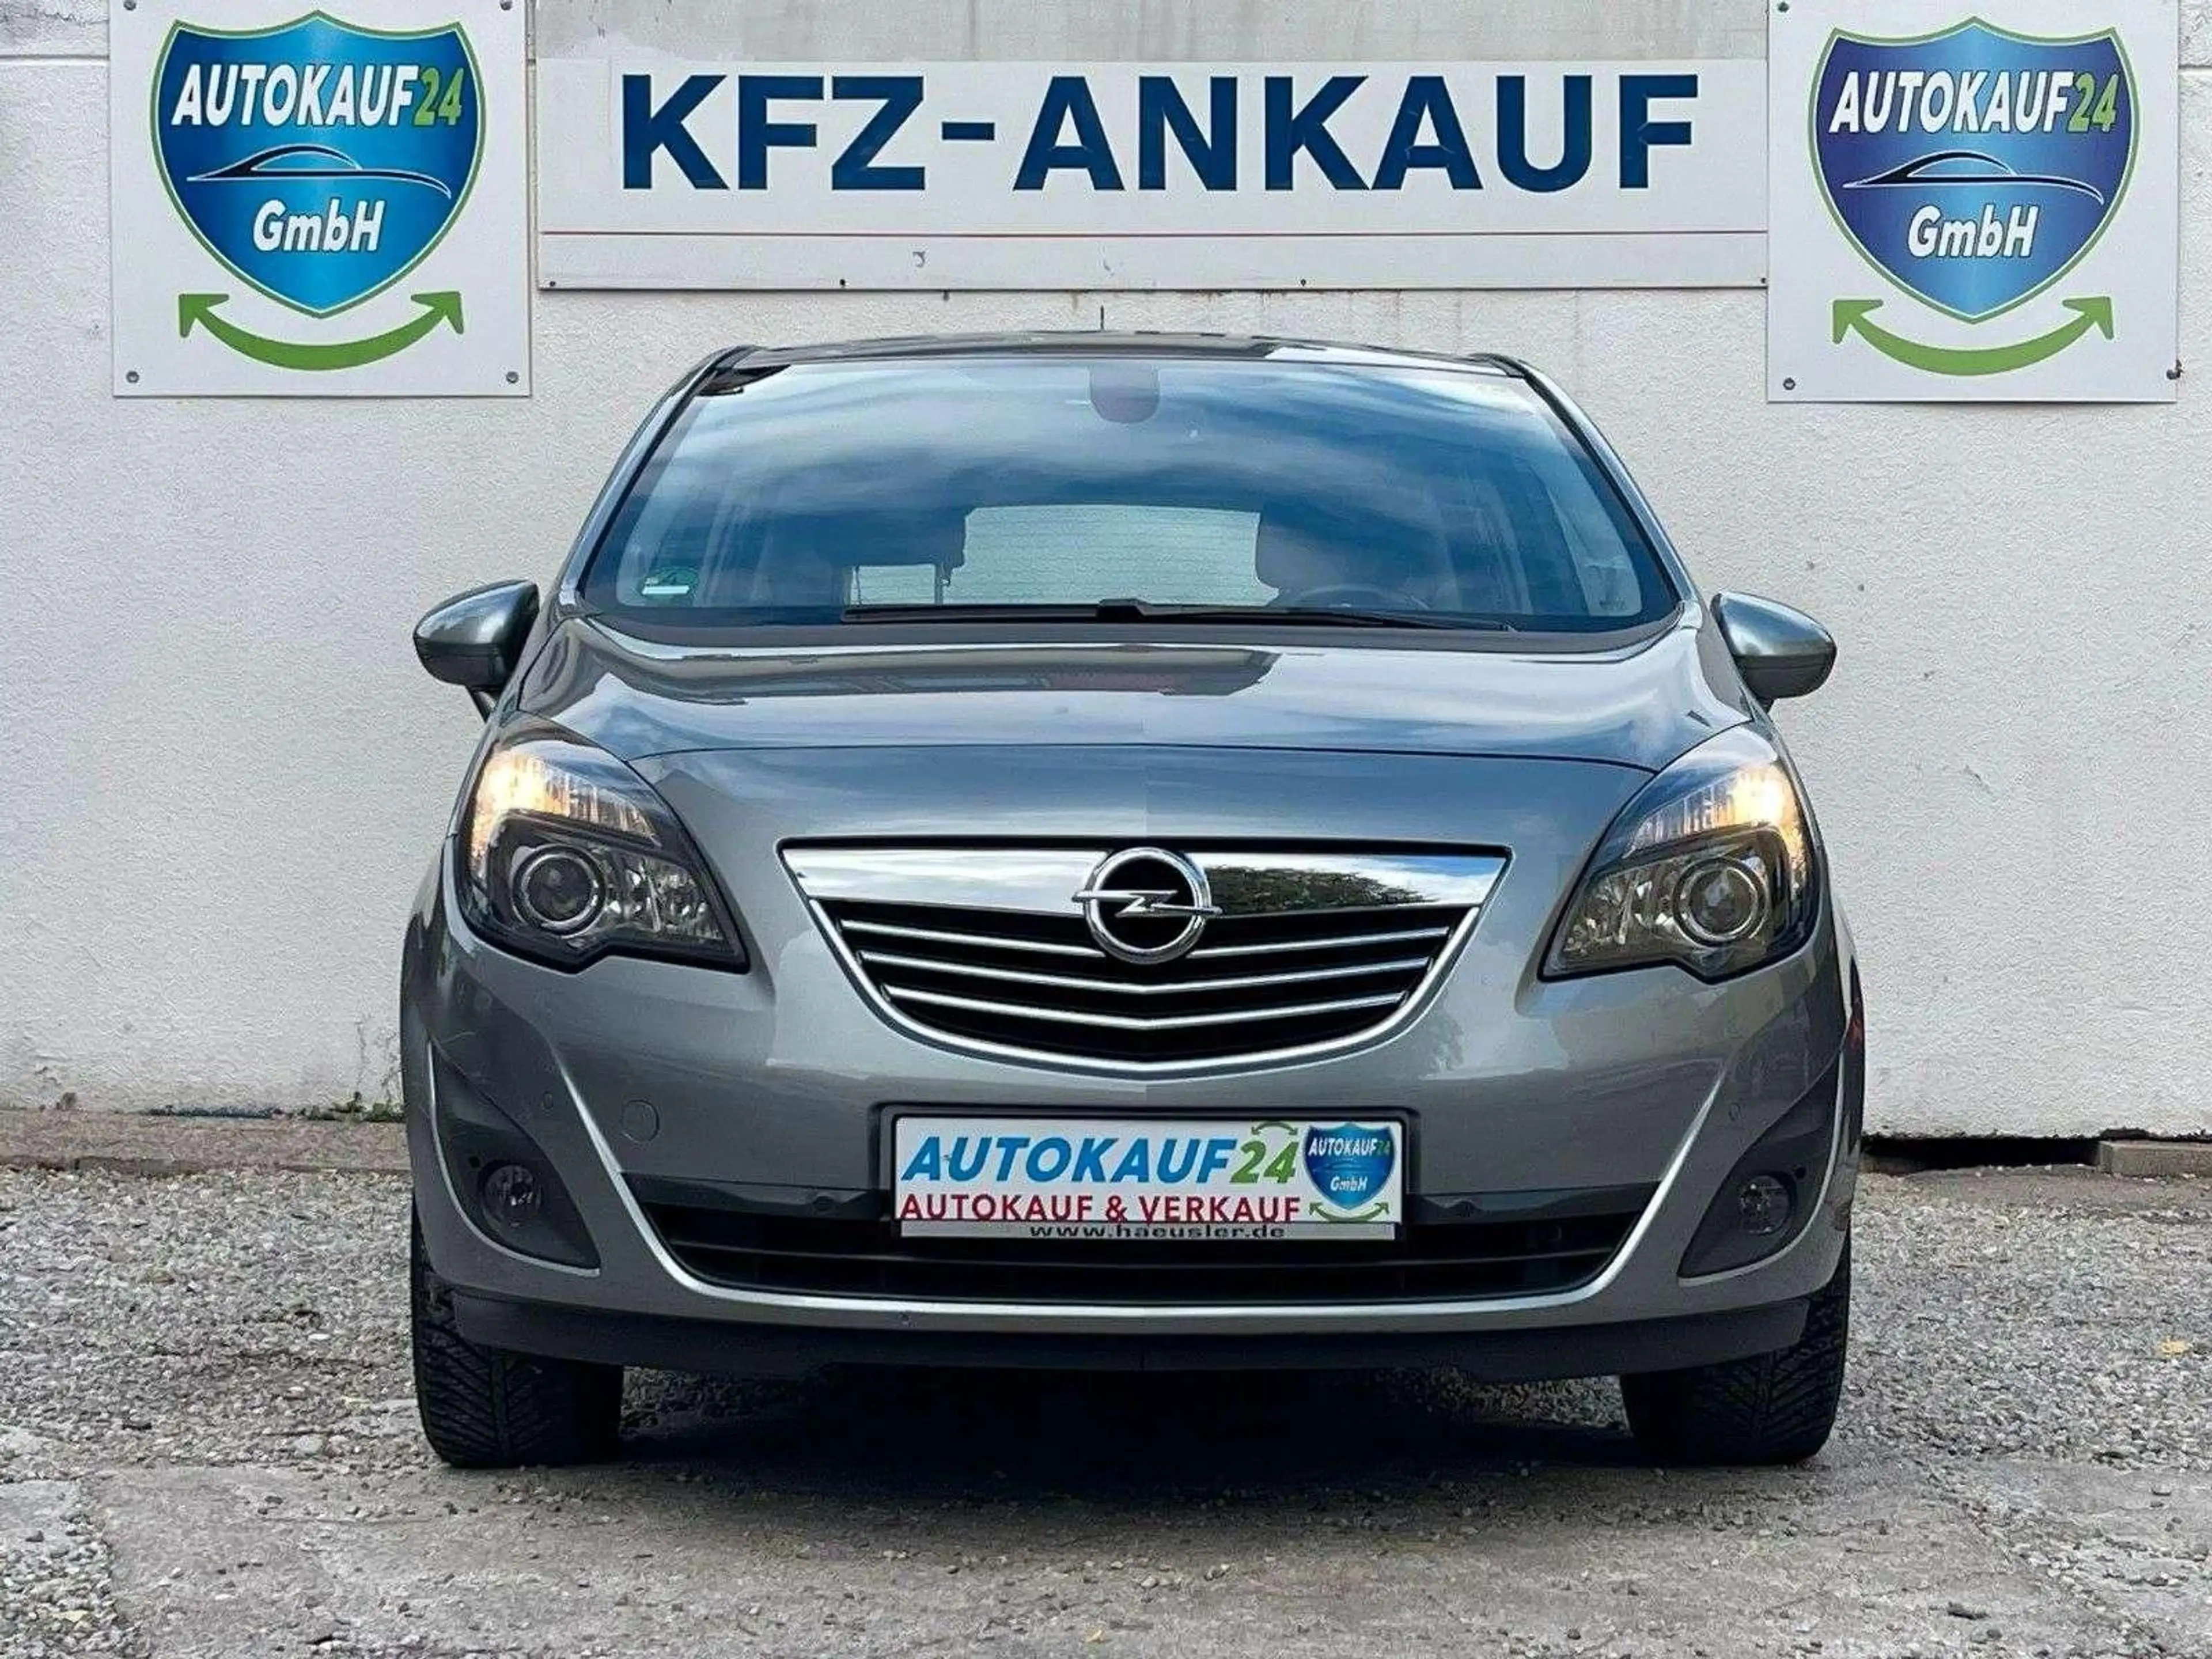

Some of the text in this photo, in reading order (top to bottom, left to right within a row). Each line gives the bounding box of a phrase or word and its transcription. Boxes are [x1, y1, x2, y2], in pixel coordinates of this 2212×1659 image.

[171, 63, 465, 126] AUTOKAUF24
[1829, 71, 2118, 133] AUTOKAUF24
[623, 74, 1698, 194] KFZ-ANKAUF
[253, 199, 385, 252] GmbH
[1907, 204, 2039, 258] GmbH
[901, 1136, 1300, 1184] AUTOKAUF24
[1308, 1137, 1391, 1157] AUTOKAUF24
[900, 1193, 1301, 1224] AUTOKAUF & VERKAUF
[1030, 1225, 1285, 1238] www.haeusler.de
